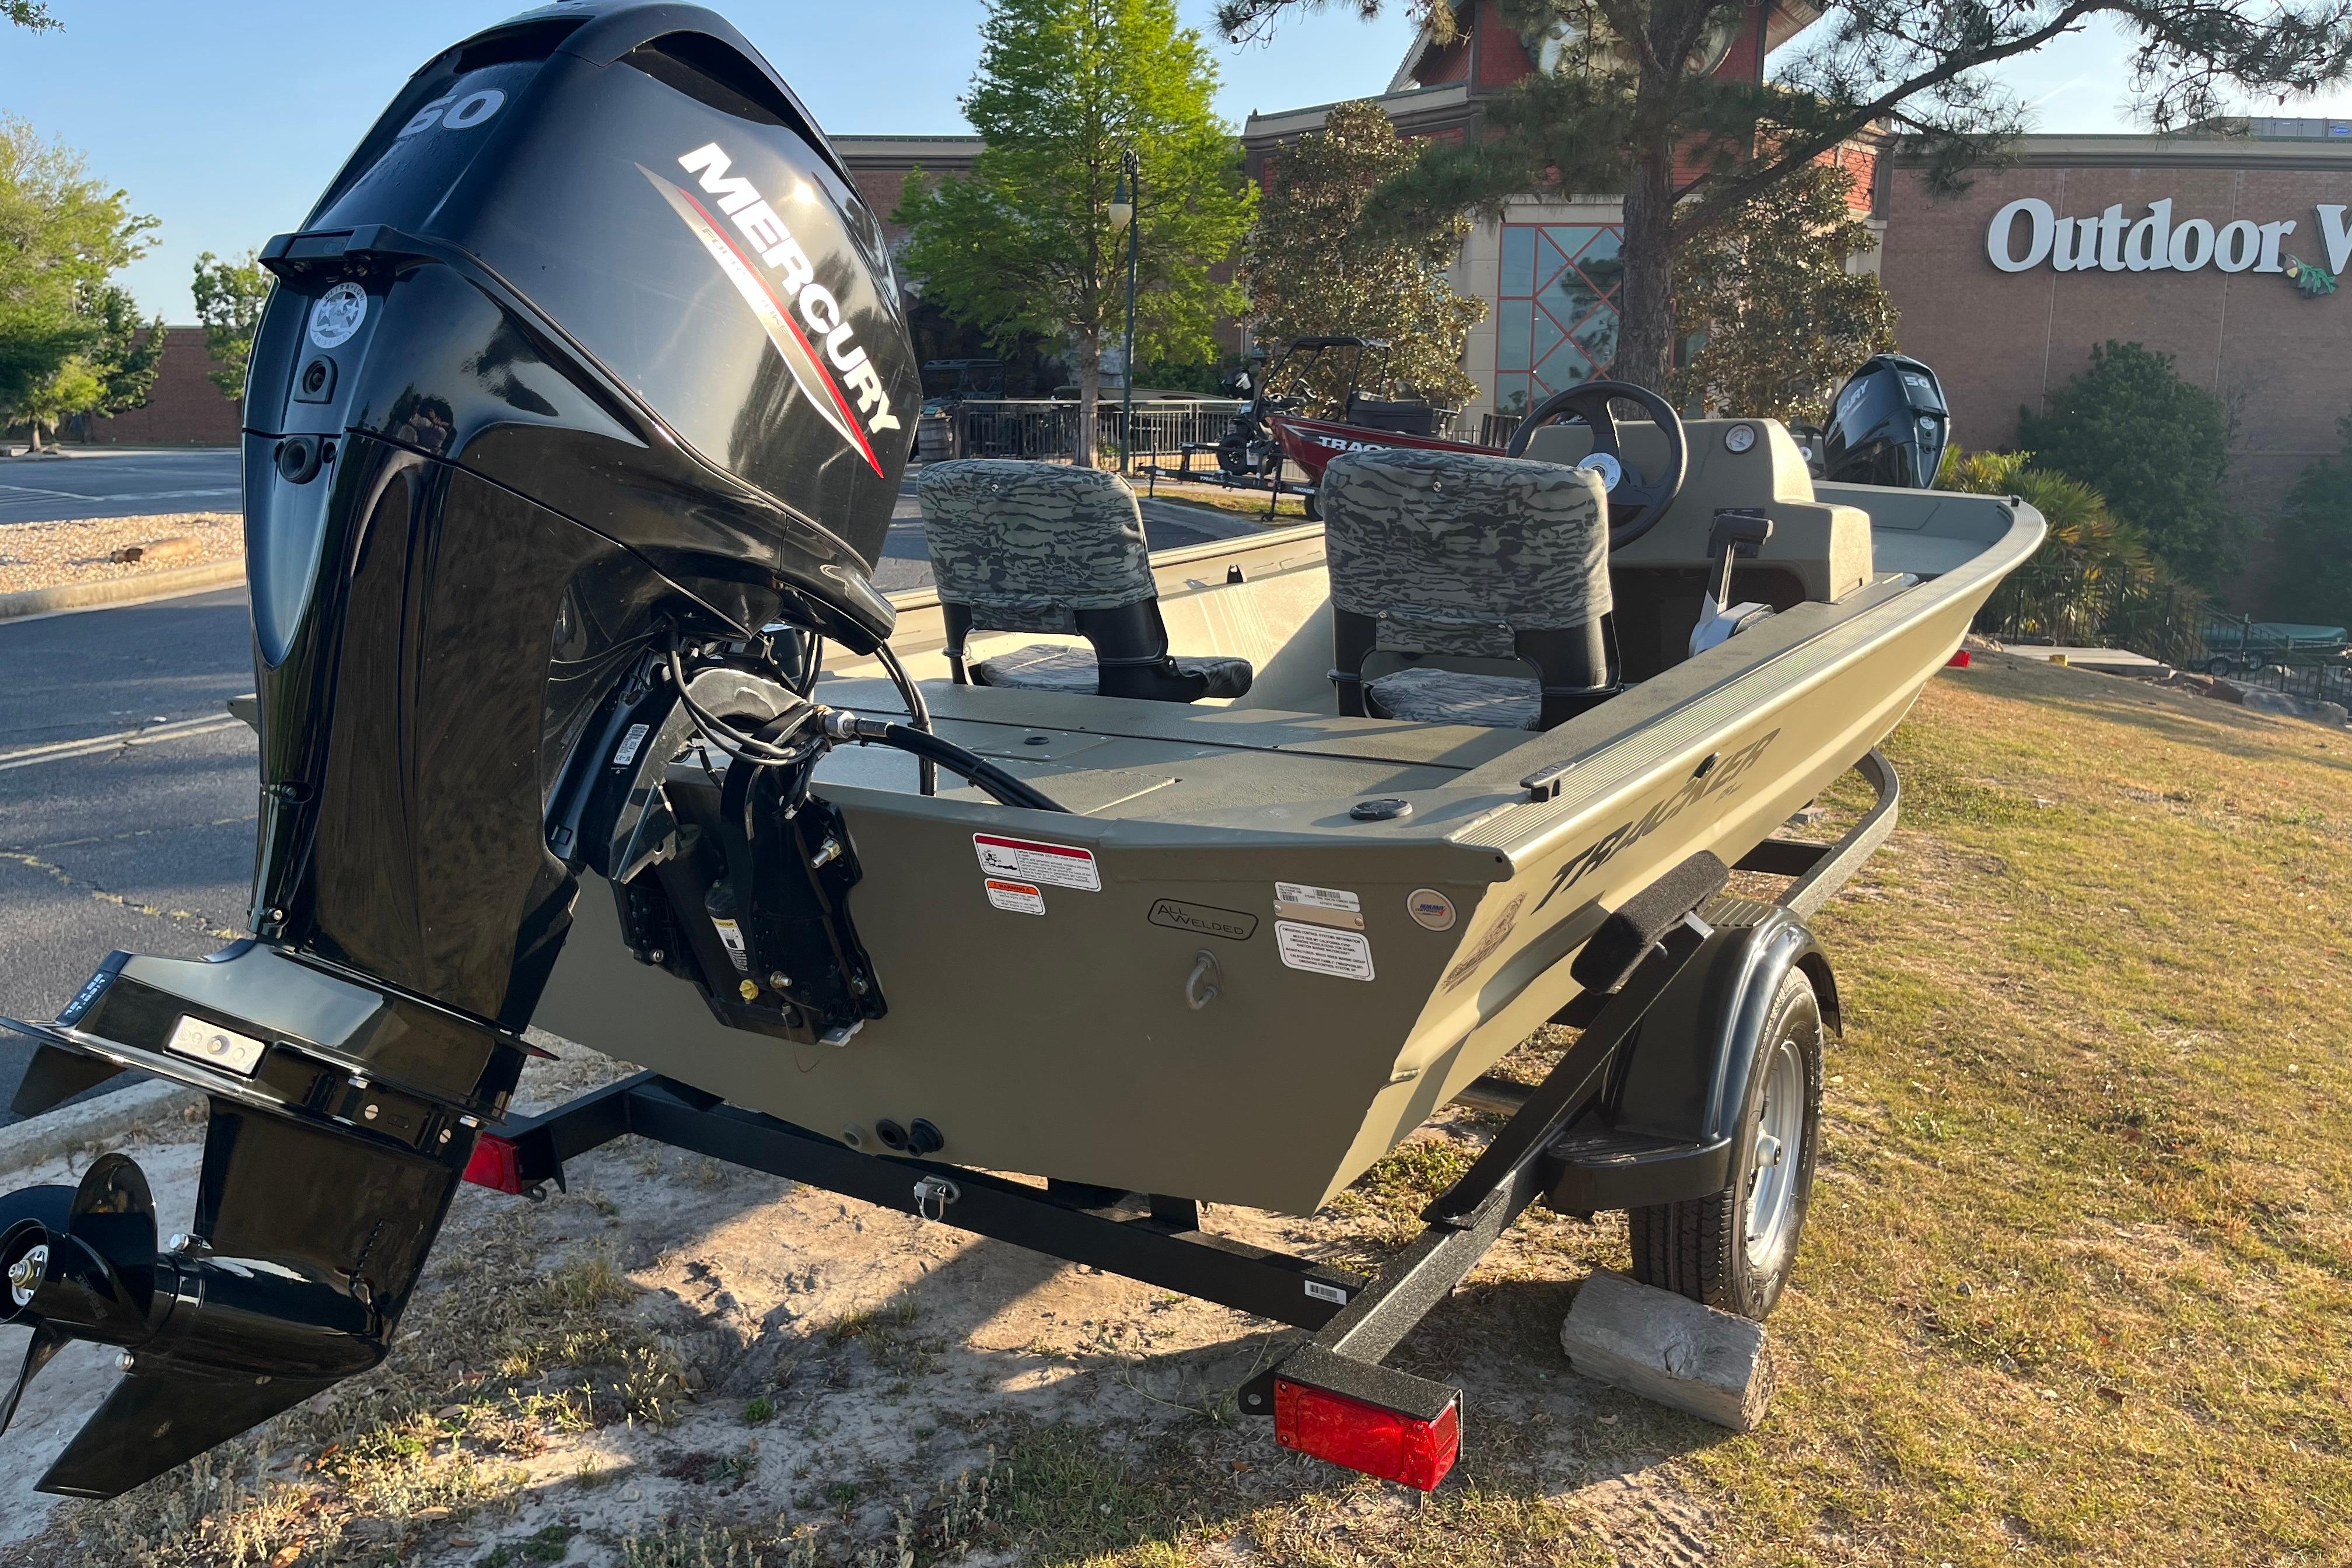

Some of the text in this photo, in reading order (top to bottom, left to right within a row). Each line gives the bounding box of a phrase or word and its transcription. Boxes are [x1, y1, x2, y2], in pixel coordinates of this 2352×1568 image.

[397, 89, 506, 138] 60
[1985, 197, 2298, 274] Outdoor
[678, 142, 901, 434] MERCURY
[1904, 376, 1930, 389] 50
[1293, 486, 1315, 495] TRACKER
[1530, 728, 1780, 915] TRACKER
[998, 884, 1026, 892] WARNING
[1157, 904, 1188, 916] ALL
[1168, 915, 1244, 935] WELDED
